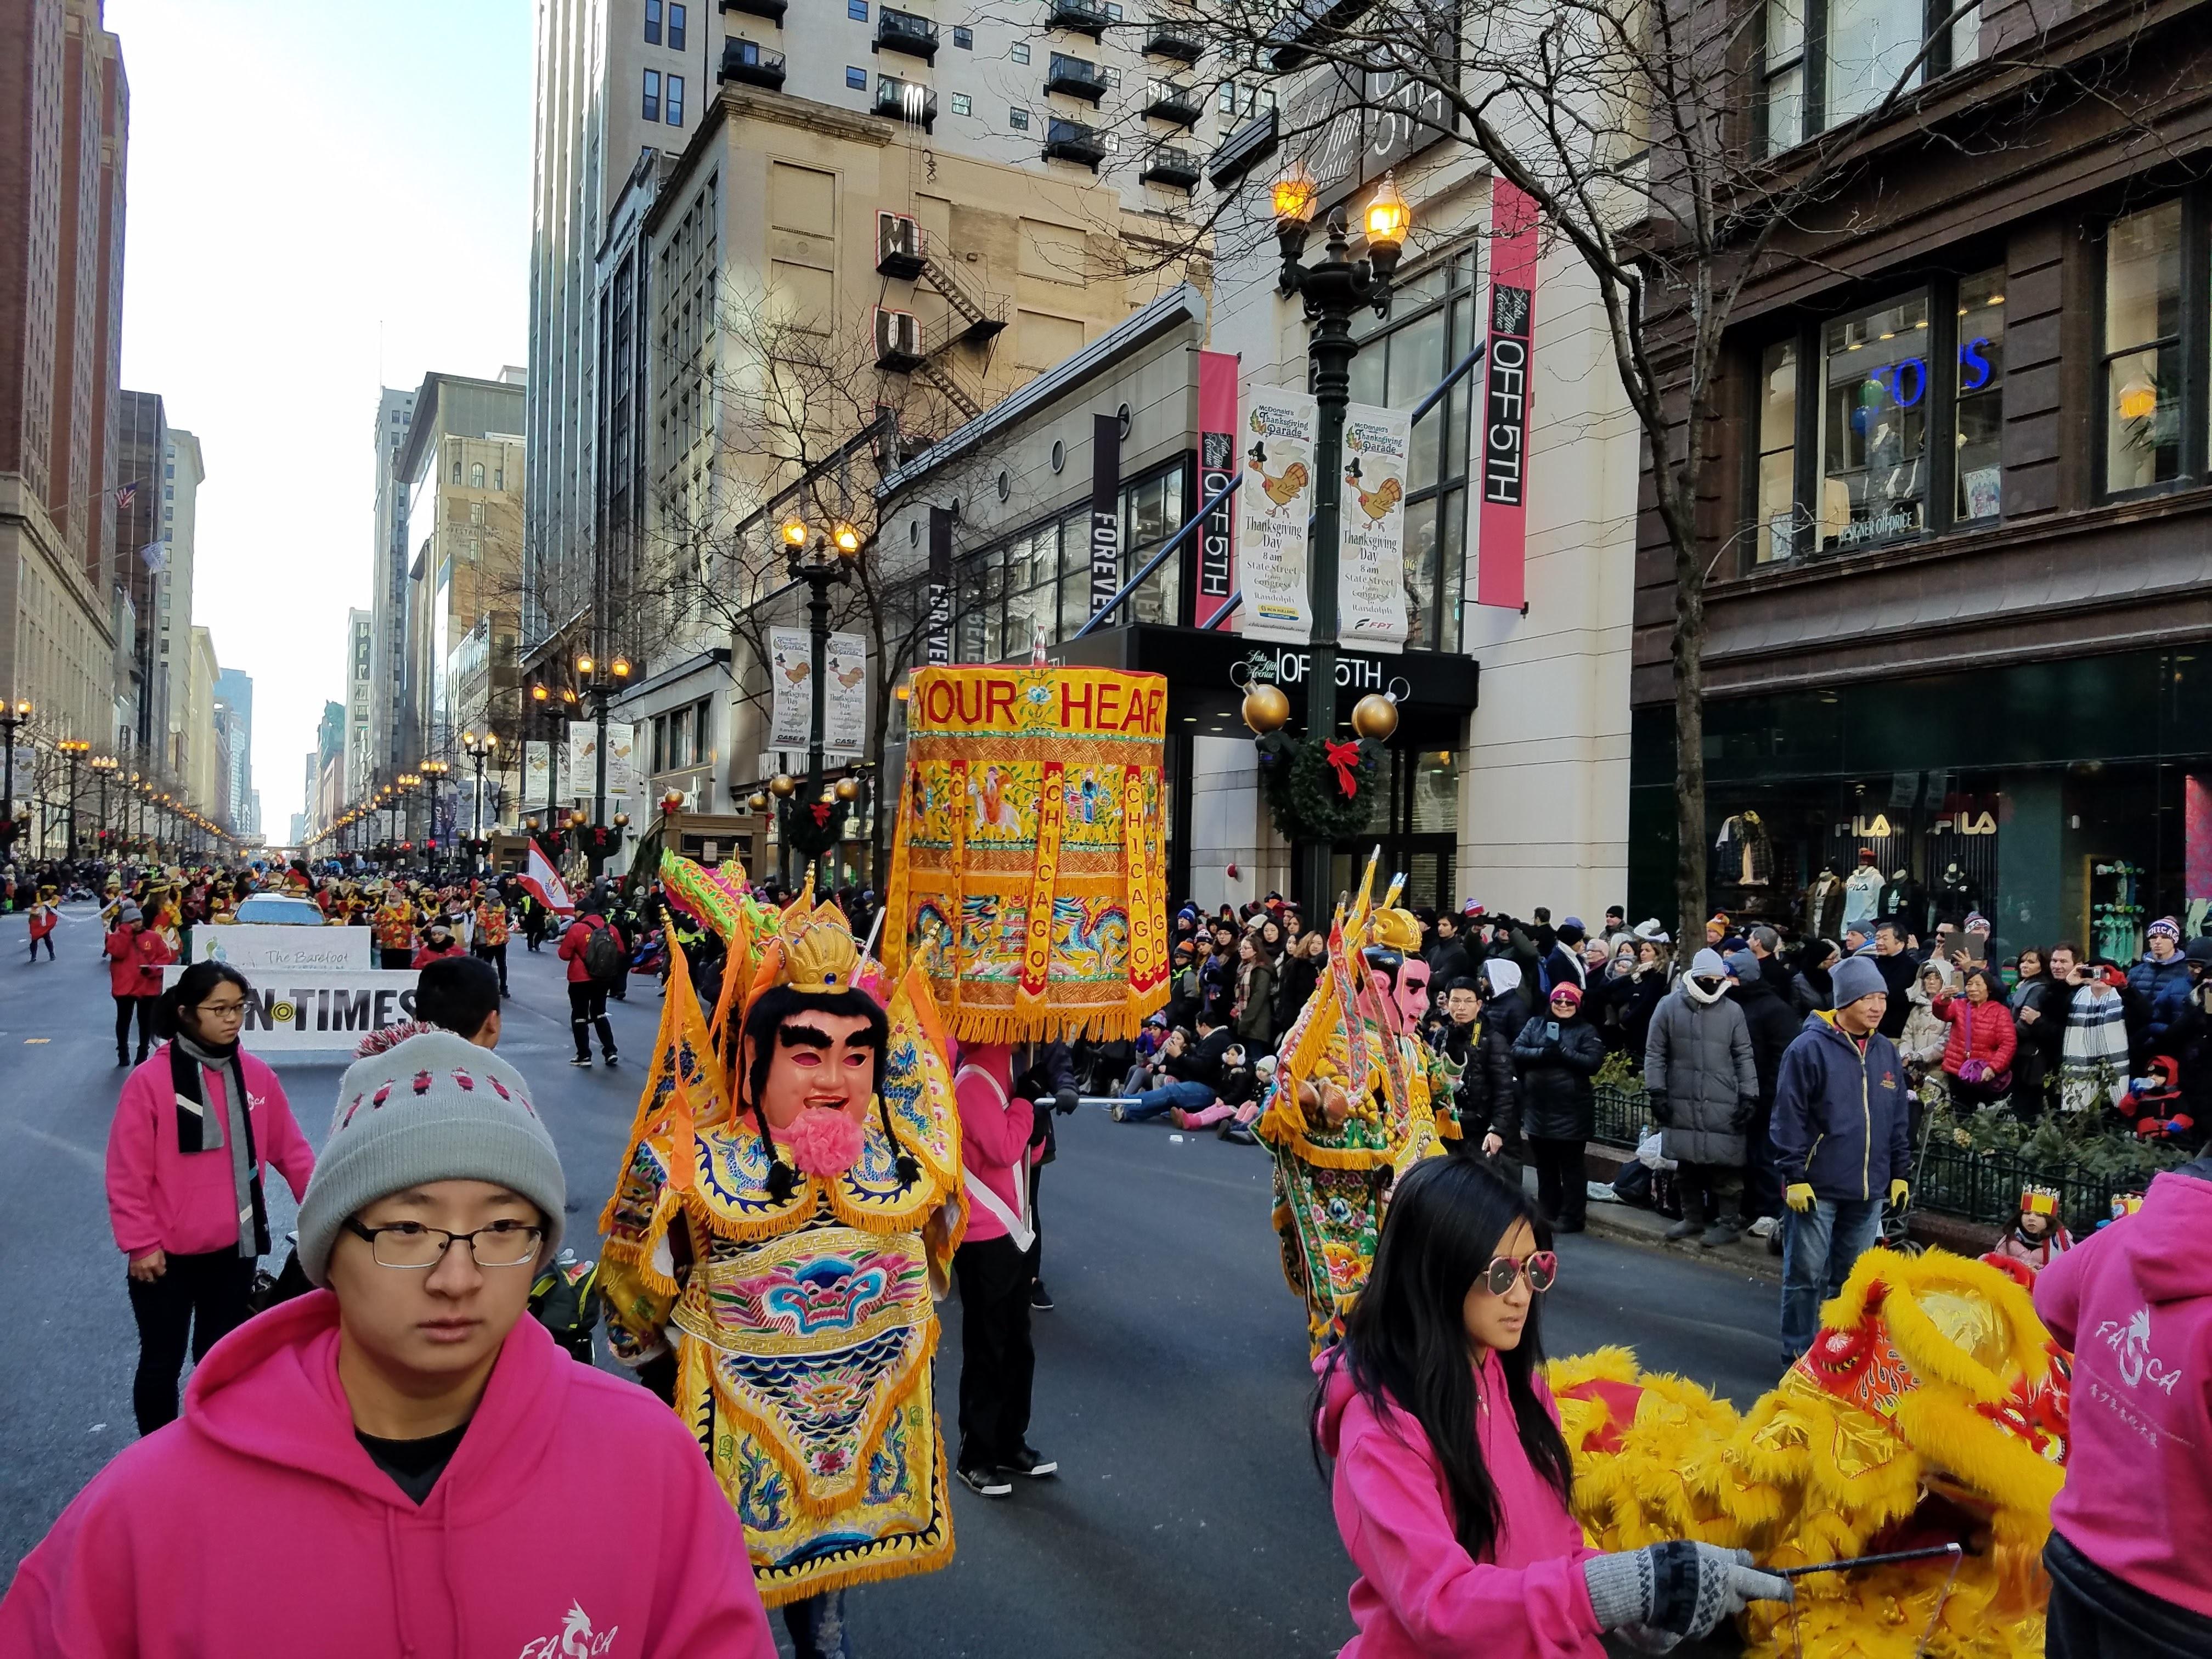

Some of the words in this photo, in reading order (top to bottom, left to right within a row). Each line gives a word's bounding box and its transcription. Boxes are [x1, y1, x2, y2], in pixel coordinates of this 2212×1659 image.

[1258, 405, 1295, 416] McDonald's
[1259, 411, 1308, 431] Thanksgiving
[1355, 422, 1389, 433] McDonald's
[1265, 424, 1302, 438] Parade
[1355, 429, 1403, 447] Thanksgiving
[1361, 441, 1396, 454] Parade
[1246, 516, 1302, 540] Thanksgiving
[1263, 534, 1282, 552] Day
[1344, 530, 1397, 554] Thanksgiving
[1360, 548, 1379, 565] Day
[1247, 561, 1269, 571] State
[1271, 564, 1297, 574] Street
[1345, 573, 1367, 583] State
[1369, 576, 1393, 586] Street
[1281, 653, 1311, 683] OF
[916, 679, 1017, 728] YOUR
[1030, 784, 1063, 968] CHICAGO
[1127, 787, 1149, 964] CHICAGO
[266, 950, 290, 964] The
[295, 950, 349, 964] Barefoot
